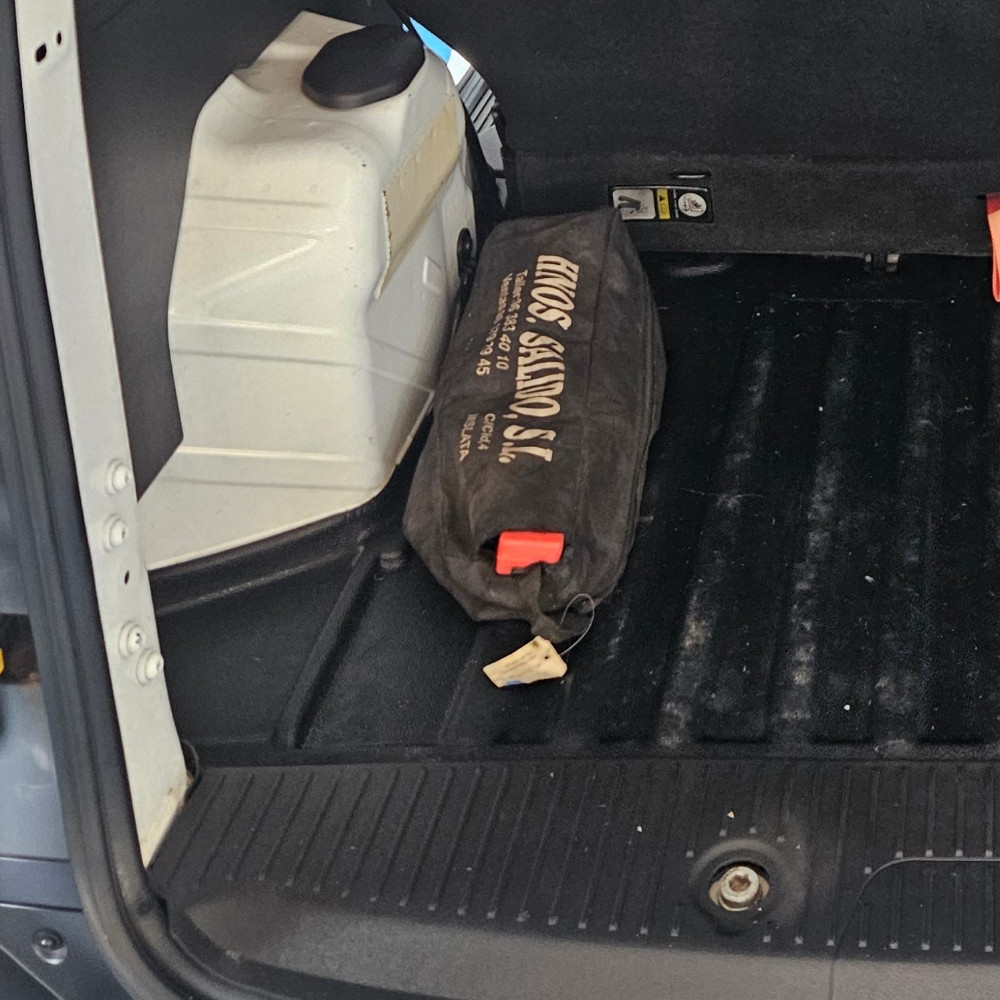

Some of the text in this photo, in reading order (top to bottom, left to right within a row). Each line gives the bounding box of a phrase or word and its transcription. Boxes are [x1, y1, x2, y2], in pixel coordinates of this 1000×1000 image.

[498, 333, 512, 353] 40
[475, 358, 492, 376] 45
[495, 355, 510, 371] 10
[498, 254, 580, 464] HNOS. SALIDO, S.L.
